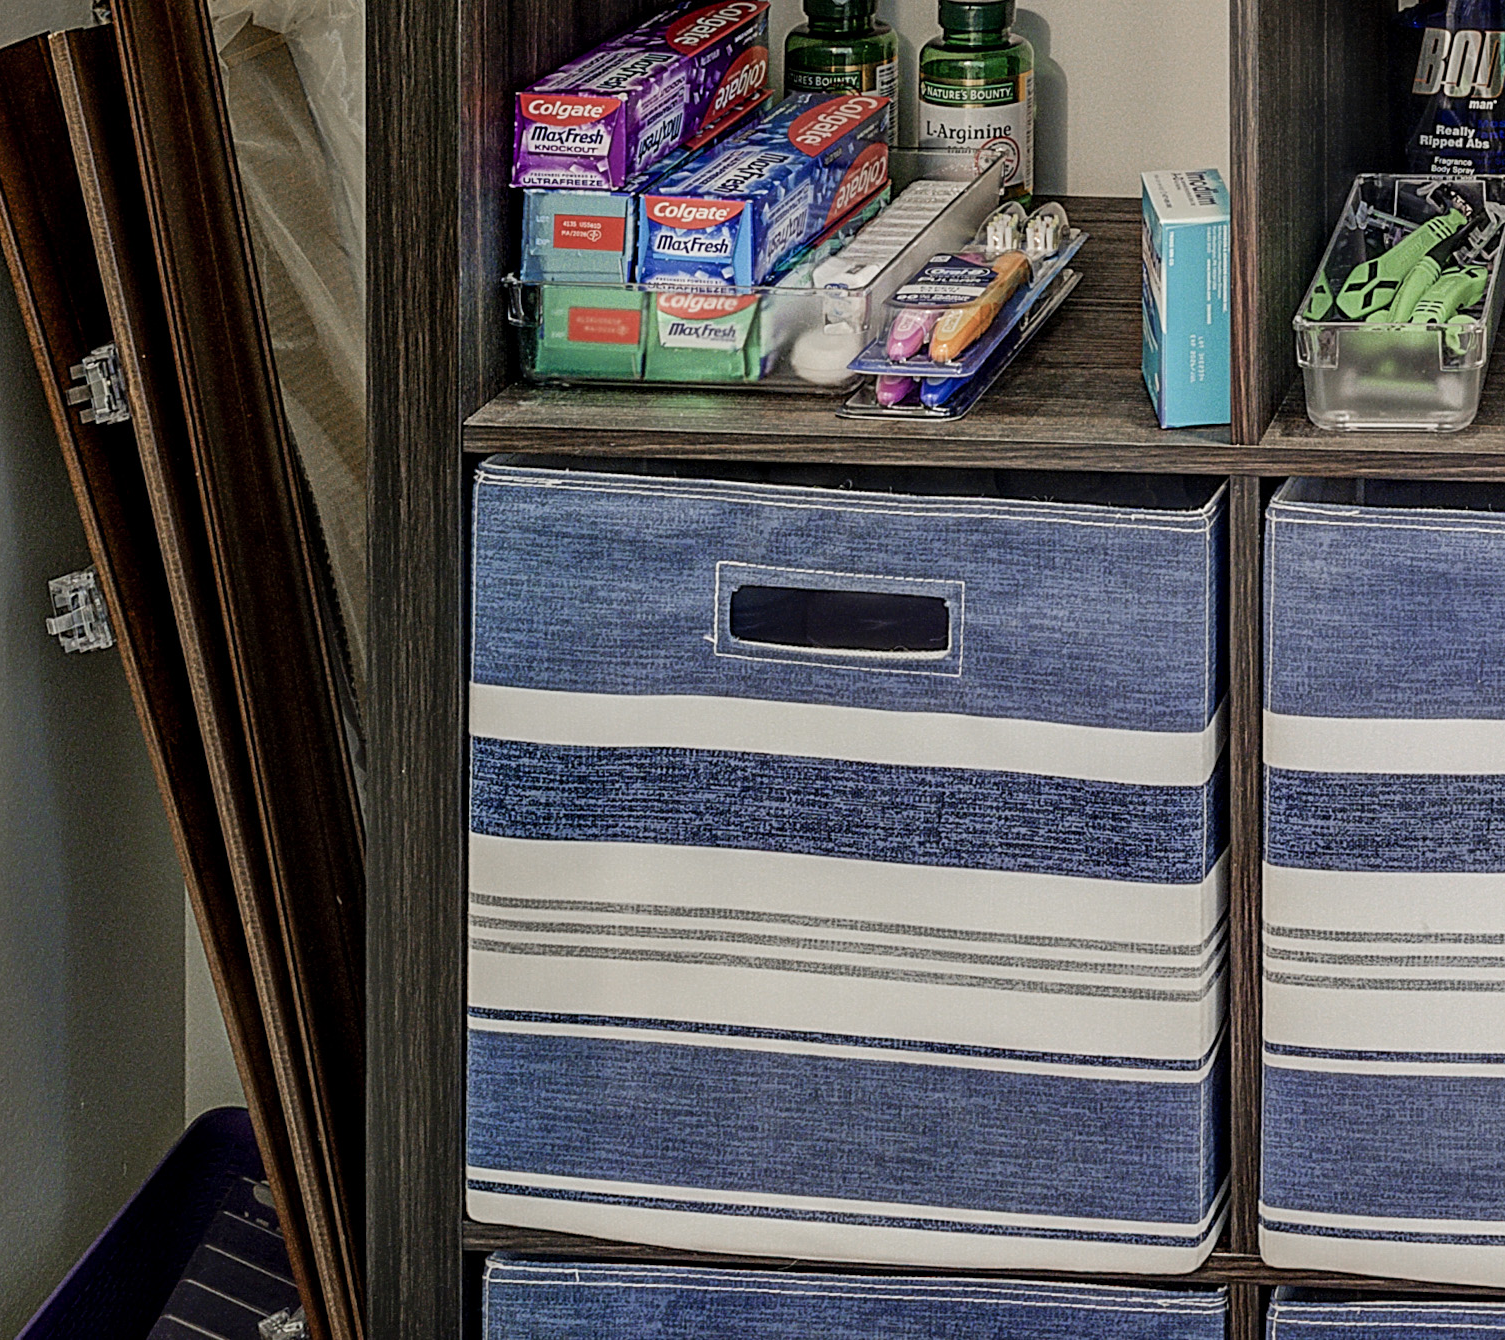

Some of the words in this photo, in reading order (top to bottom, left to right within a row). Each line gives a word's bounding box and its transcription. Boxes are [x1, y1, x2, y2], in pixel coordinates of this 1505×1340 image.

[674, 1, 757, 46] Colgate
[715, 60, 765, 110] Colgate
[815, 76, 858, 87] BOUNTY
[927, 87, 968, 100] NATURE'S
[970, 87, 1011, 100] BOUNTY
[528, 100, 603, 120] Colgate
[1469, 100, 1493, 110] man
[796, 96, 878, 146] Colgate
[531, 126, 604, 144] MaxFresh
[926, 120, 1012, 144] L-Arginine
[1435, 124, 1475, 138] Really
[535, 144, 597, 154] KNOCKOUT
[1419, 134, 1463, 149] Ripped
[1465, 135, 1490, 149] Abs
[1431, 164, 1451, 174] Body
[1453, 166, 1475, 176] Spray
[1433, 156, 1473, 166] Fragrance
[523, 177, 603, 187] ULTRAFREEZE
[714, 152, 790, 195] MaxFresh
[837, 156, 886, 210] Colgate
[653, 202, 727, 222] Colgate
[657, 234, 729, 254] MaxFresh
[659, 294, 738, 312] Colgate
[668, 322, 736, 338] MaxFresh
